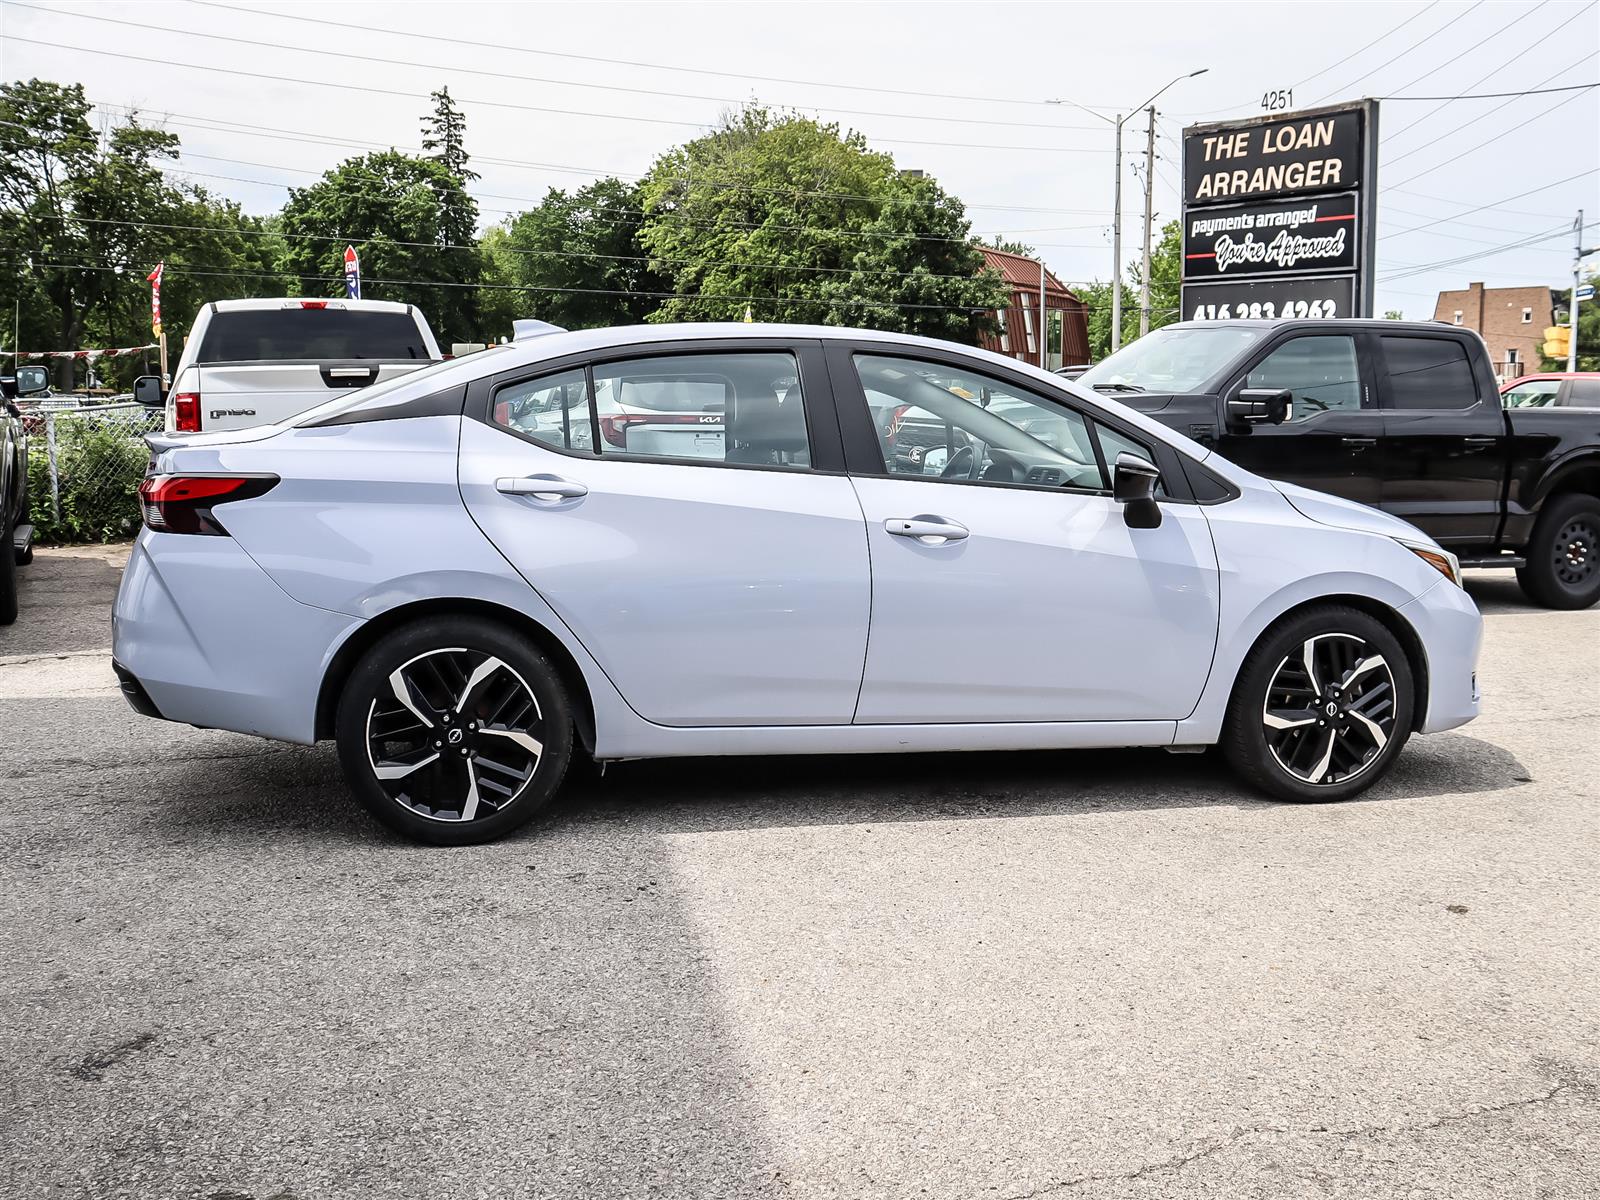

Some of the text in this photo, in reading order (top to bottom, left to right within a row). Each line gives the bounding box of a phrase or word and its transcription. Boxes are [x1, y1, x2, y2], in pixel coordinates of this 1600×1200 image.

[1261, 88, 1293, 111] 4251
[1202, 119, 1335, 162] THE LOAN
[1195, 158, 1343, 198] ARRANGER
[1191, 205, 1318, 237] payments arranged
[1214, 227, 1346, 272] You're Approved
[1193, 299, 1337, 321] 416 283 4262
